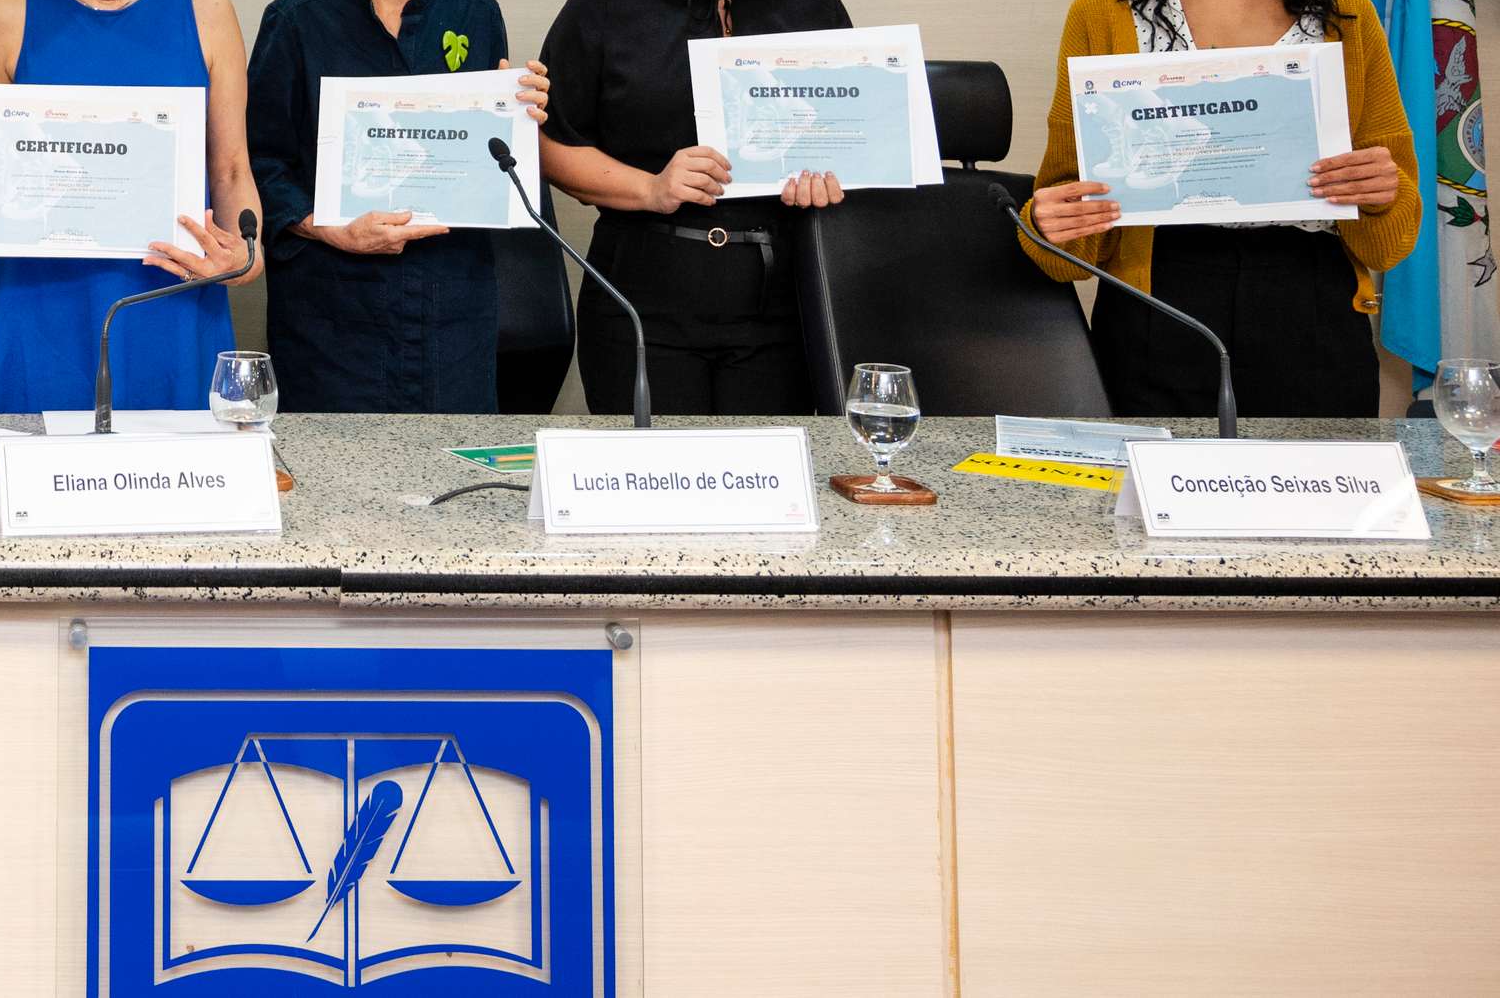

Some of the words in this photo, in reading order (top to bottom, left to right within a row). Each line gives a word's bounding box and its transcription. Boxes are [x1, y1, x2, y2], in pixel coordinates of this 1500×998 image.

[748, 86, 861, 98] CERTIFICADO
[1131, 98, 1259, 121] CERTIFICADO
[367, 127, 469, 140] CERTIFICADO
[15, 140, 128, 155] CERTIFICADO
[53, 474, 108, 492] Eliana
[113, 472, 171, 491] Olinda
[177, 471, 226, 489] Alves
[573, 472, 620, 491] Lucia
[625, 472, 691, 491] Rabello
[696, 471, 717, 490] de
[722, 471, 779, 490] Castro
[1170, 474, 1267, 498] Conceição
[1270, 474, 1332, 494] Seixas
[1336, 474, 1381, 494] Silva
